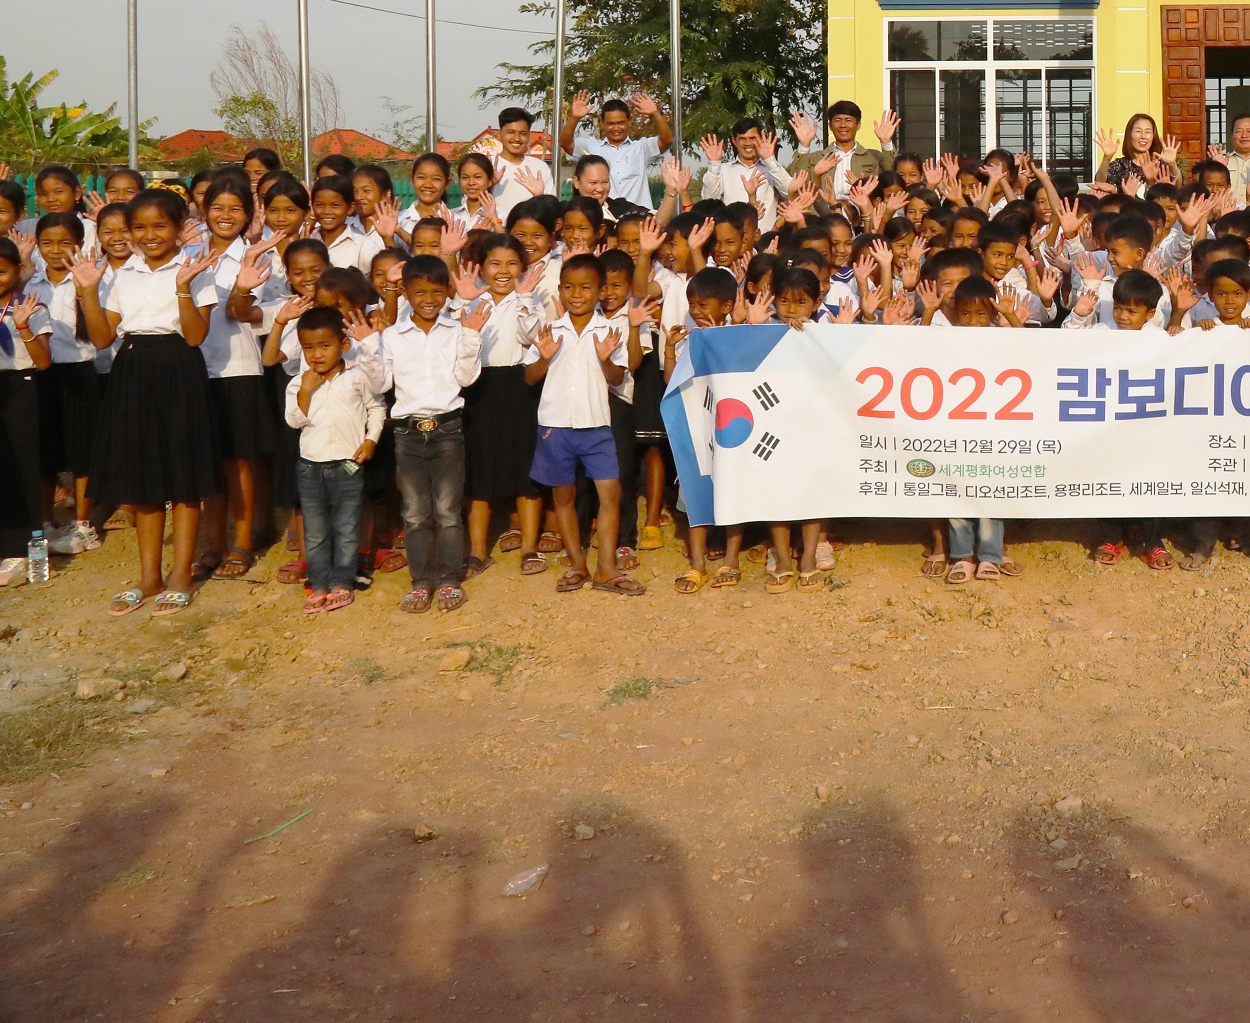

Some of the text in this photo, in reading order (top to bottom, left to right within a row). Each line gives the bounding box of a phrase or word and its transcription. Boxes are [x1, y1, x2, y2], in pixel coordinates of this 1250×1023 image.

[854, 366, 1034, 421] 2022
[859, 434, 1063, 455] 일시 2022년 12월 29일 (목)
[1208, 434, 1237, 450] 장소
[858, 458, 1048, 478] 주최 세계평화여성연합
[1208, 458, 1237, 473] 주관
[858, 480, 888, 497] 후원
[902, 482, 962, 498] 통일그룹,
[964, 484, 1051, 499] 디오션리조트,
[1054, 481, 1126, 498] 용평리조트,
[1128, 481, 1187, 497] 세계일보,
[1190, 481, 1248, 497] 일신석재,
